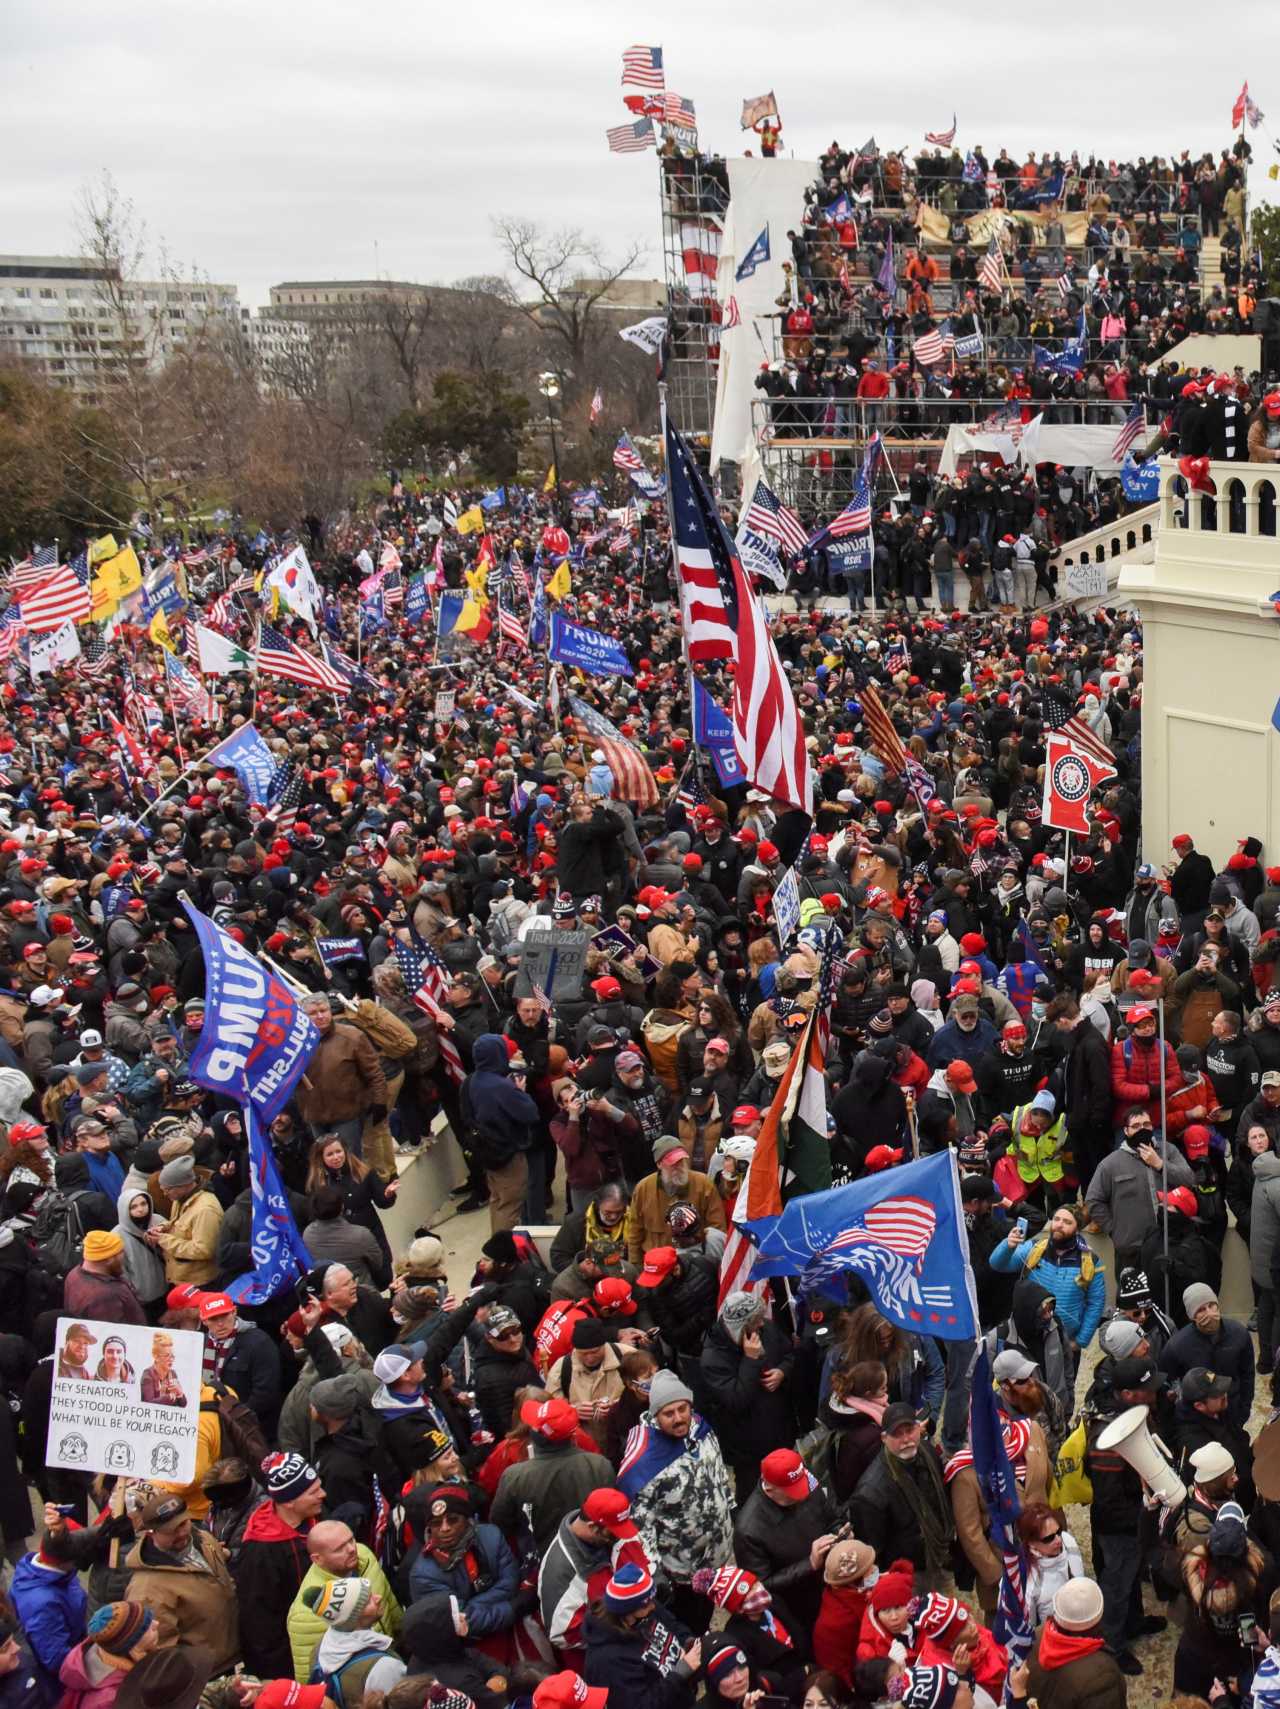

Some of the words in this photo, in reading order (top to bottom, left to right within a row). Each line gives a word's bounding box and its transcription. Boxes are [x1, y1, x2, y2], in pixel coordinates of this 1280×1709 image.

[565, 624, 620, 650] TRUMP
[707, 728, 729, 737] KEEP
[320, 938, 360, 951] TRUMP
[1085, 957, 1113, 968] BIDEN
[1003, 1063, 1033, 1076] TRUMP
[205, 1299, 225, 1310] USA
[54, 1382, 75, 1394] HEY
[76, 1383, 129, 1400] SENATORS,
[52, 1396, 76, 1408] THEY
[78, 1399, 113, 1413] STOOD
[115, 1405, 129, 1415] UP
[131, 1406, 151, 1418] FOR
[153, 1409, 189, 1423] TRUTH.
[52, 1412, 80, 1424] WHAT
[83, 1415, 107, 1428] WILL
[110, 1418, 122, 1429] BE
[126, 1420, 153, 1433] YOUR
[153, 1424, 197, 1437] LEGACY?
[270, 1453, 305, 1485] TRUM
